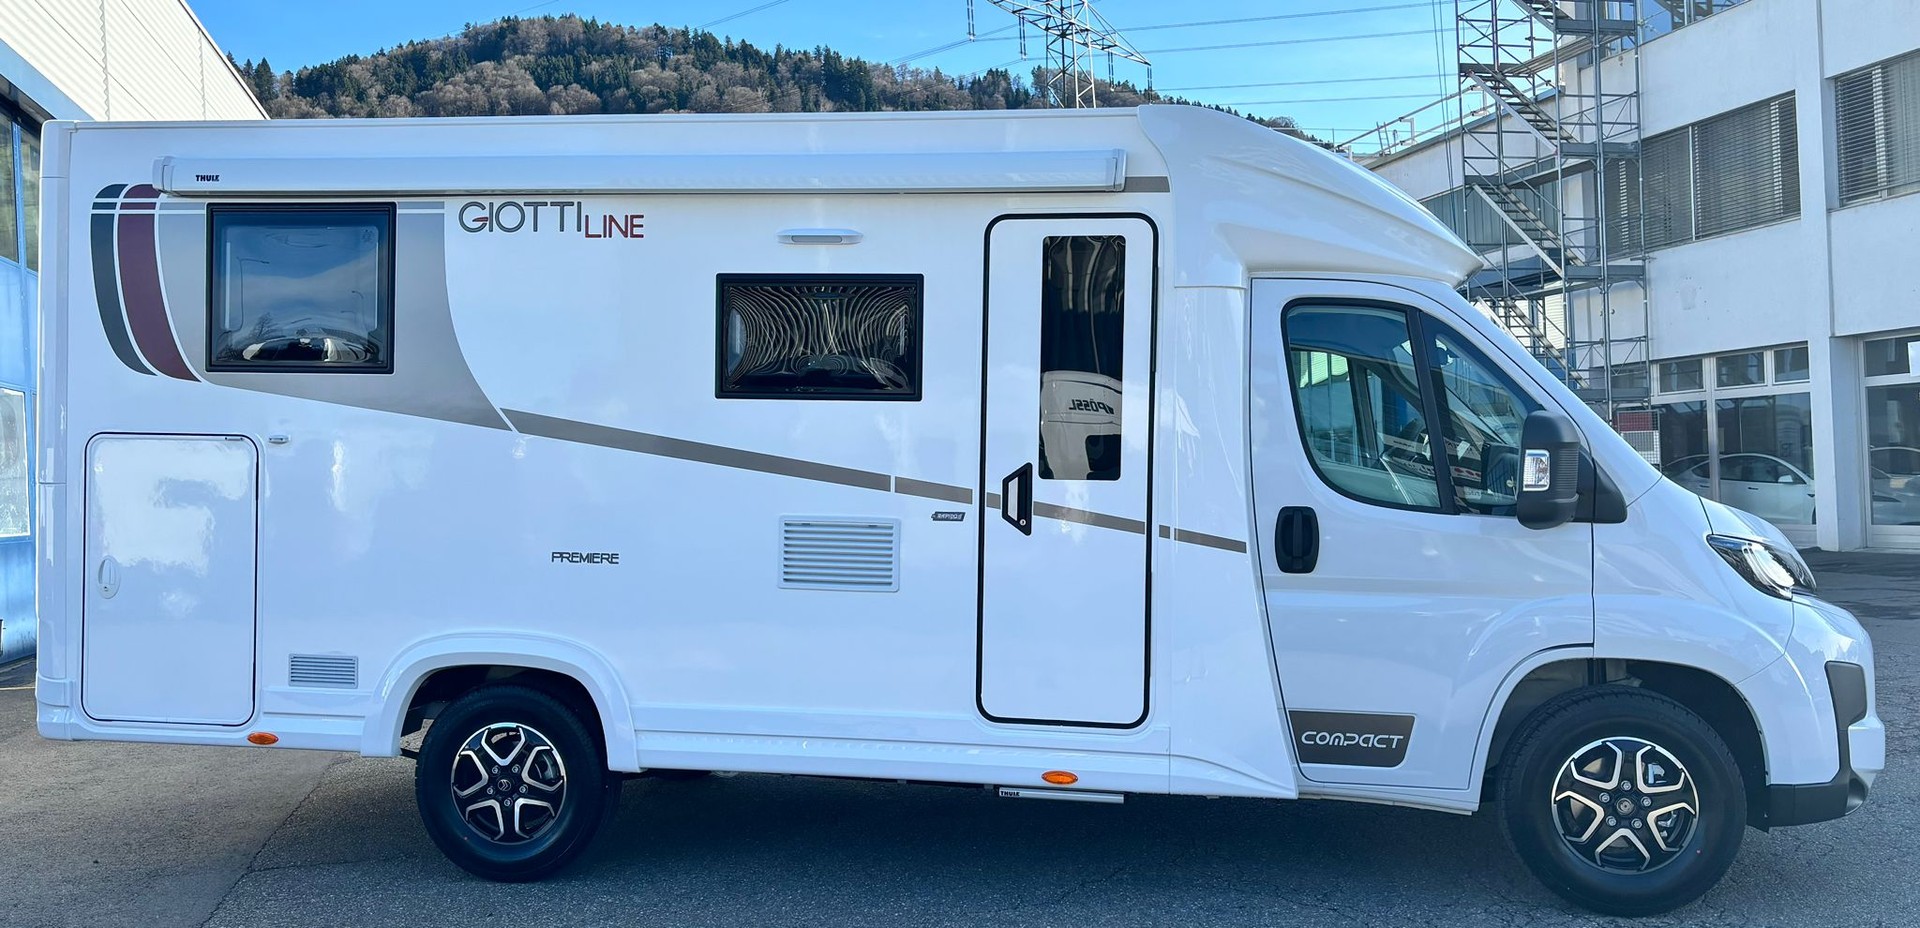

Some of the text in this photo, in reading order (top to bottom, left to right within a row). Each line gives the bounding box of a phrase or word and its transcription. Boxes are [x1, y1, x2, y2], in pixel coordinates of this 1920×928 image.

[195, 174, 220, 182] THULE
[551, 551, 620, 565] PREMIERE
[1301, 731, 1404, 749] COMPACT
